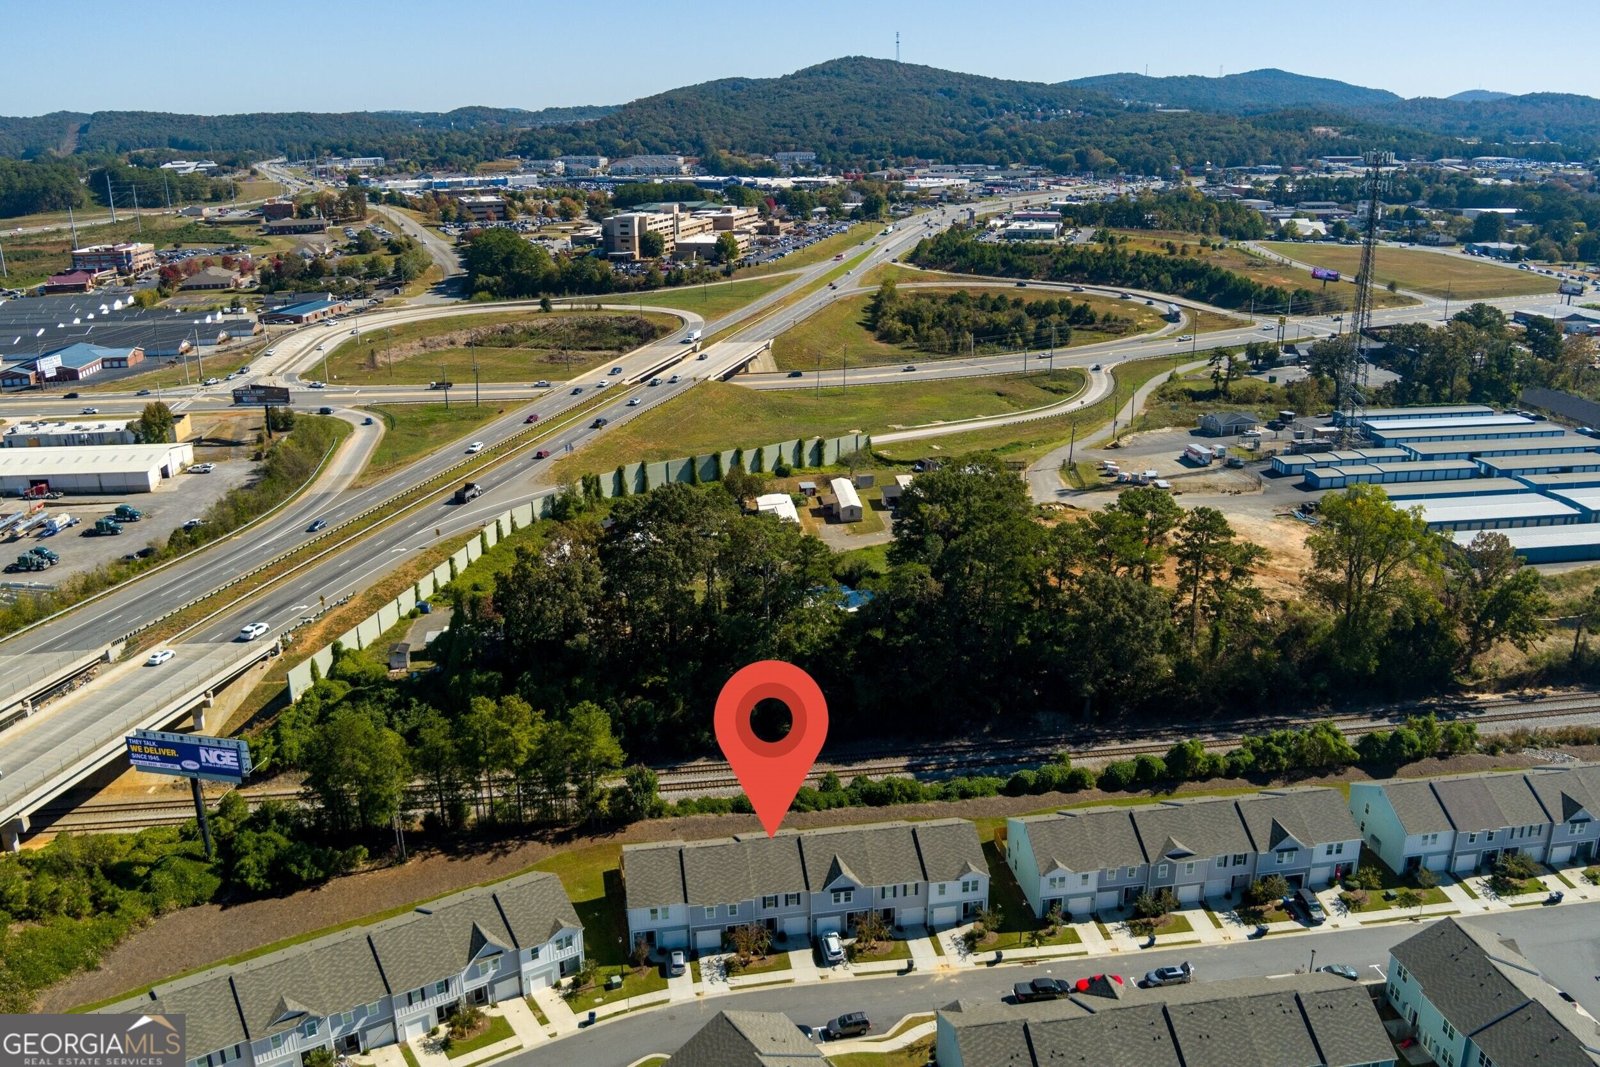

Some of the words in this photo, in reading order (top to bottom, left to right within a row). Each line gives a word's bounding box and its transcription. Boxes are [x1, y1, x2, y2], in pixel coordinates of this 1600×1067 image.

[130, 745, 143, 754] WE
[144, 746, 179, 757] DELIVER.
[199, 749, 239, 766] NGE
